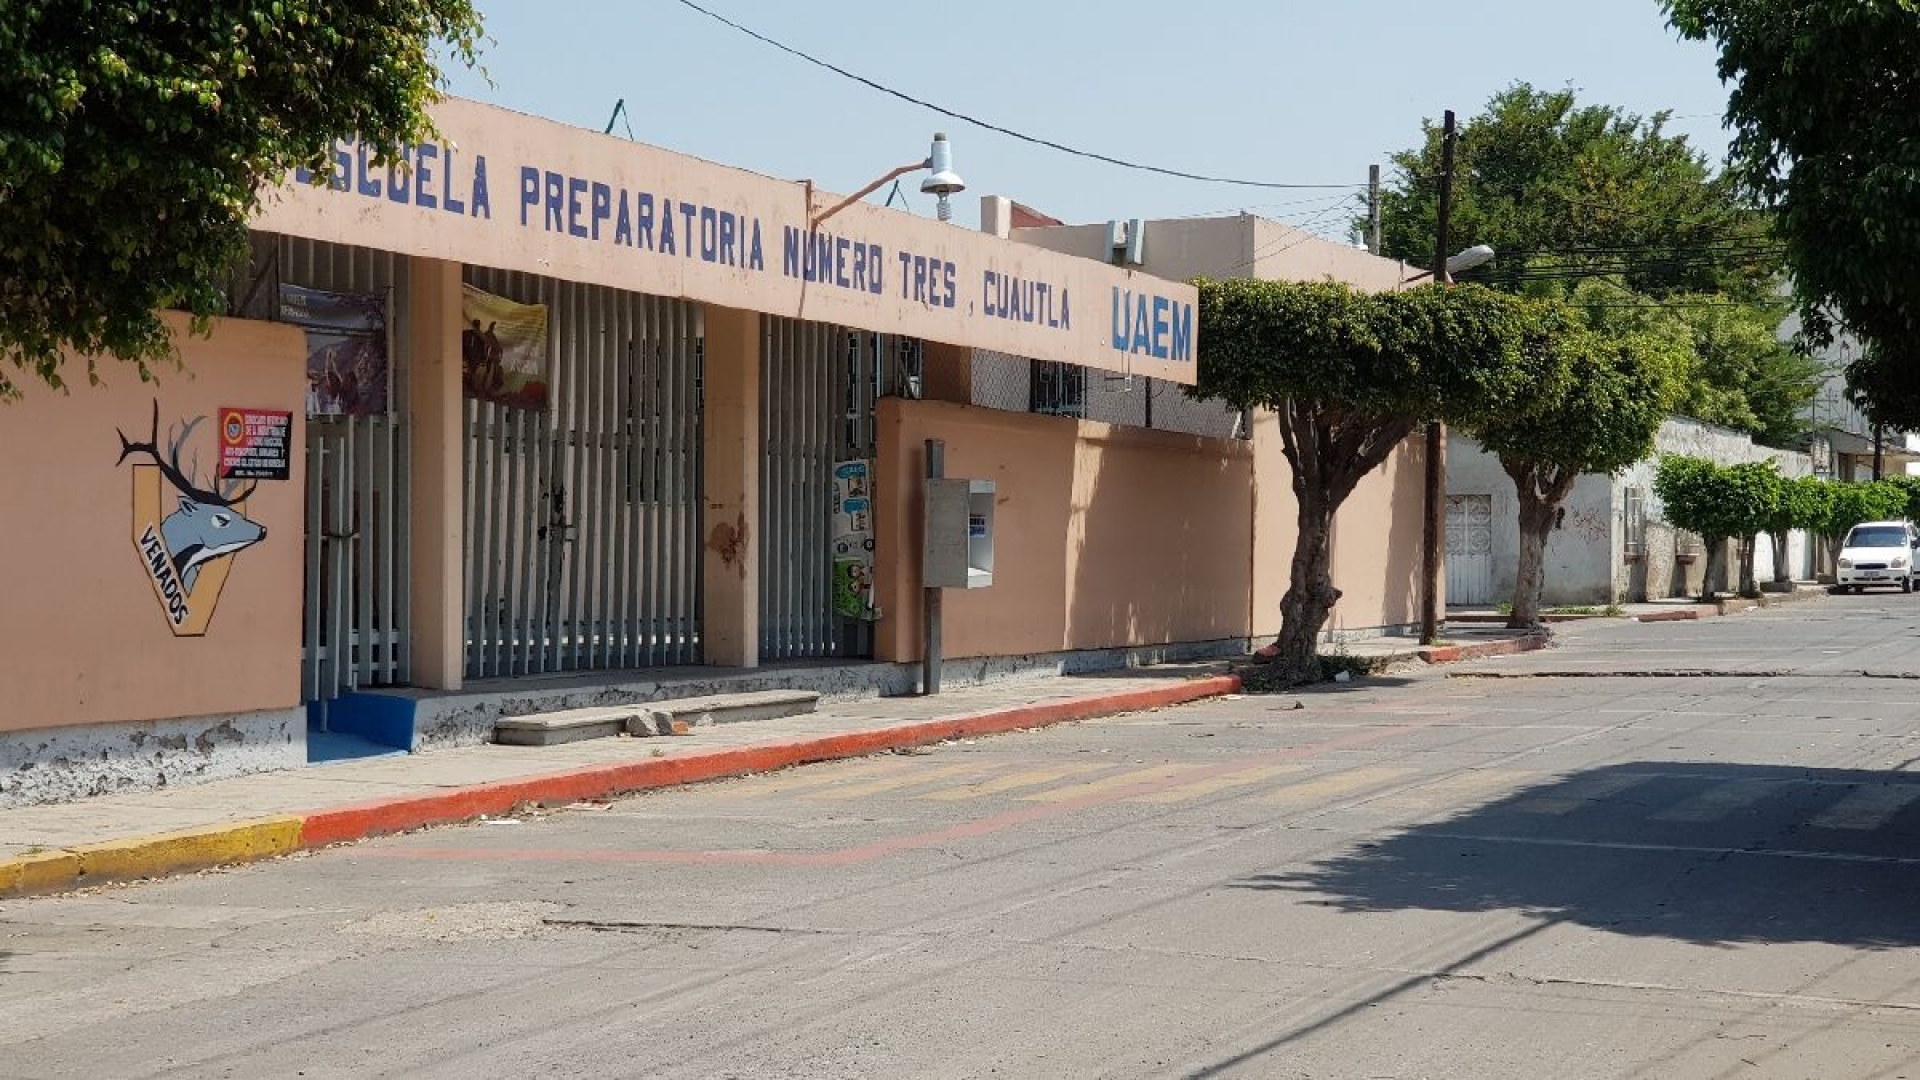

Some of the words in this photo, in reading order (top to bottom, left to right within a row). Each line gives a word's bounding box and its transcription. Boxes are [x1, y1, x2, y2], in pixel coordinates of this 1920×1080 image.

[521, 166, 764, 271] PREPARATORIA
[899, 251, 957, 308] TRES
[984, 270, 1070, 331] CUAUTLA
[1112, 285, 1192, 361] UAEM
[140, 525, 189, 625] VENADOS
